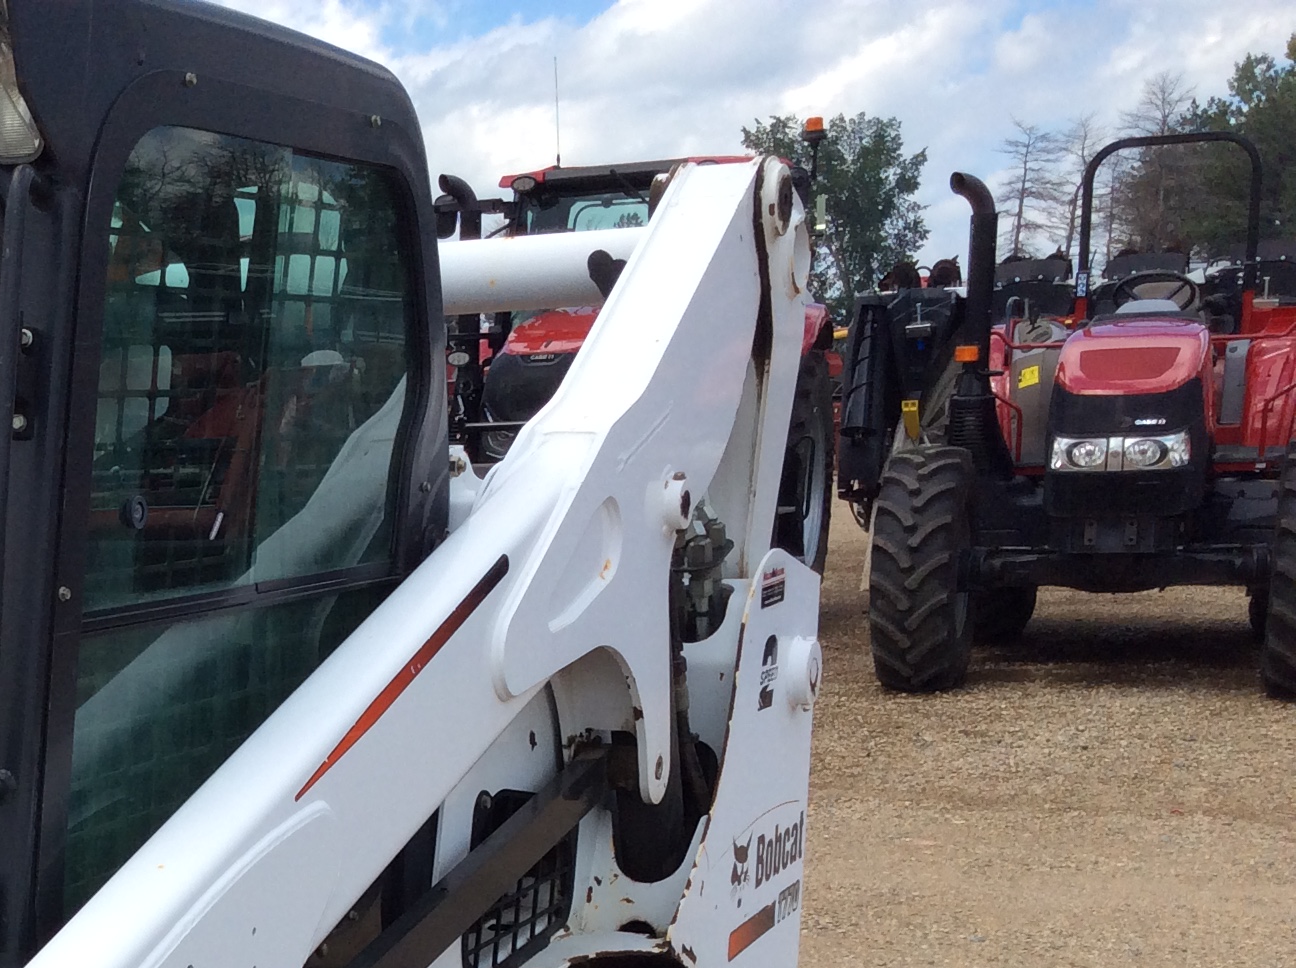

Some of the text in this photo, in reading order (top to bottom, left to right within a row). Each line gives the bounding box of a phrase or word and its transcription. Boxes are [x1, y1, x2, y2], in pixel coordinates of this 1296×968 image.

[1134, 418, 1157, 426] CASE
[755, 810, 804, 900] Bobcat
[777, 879, 801, 925] T770
